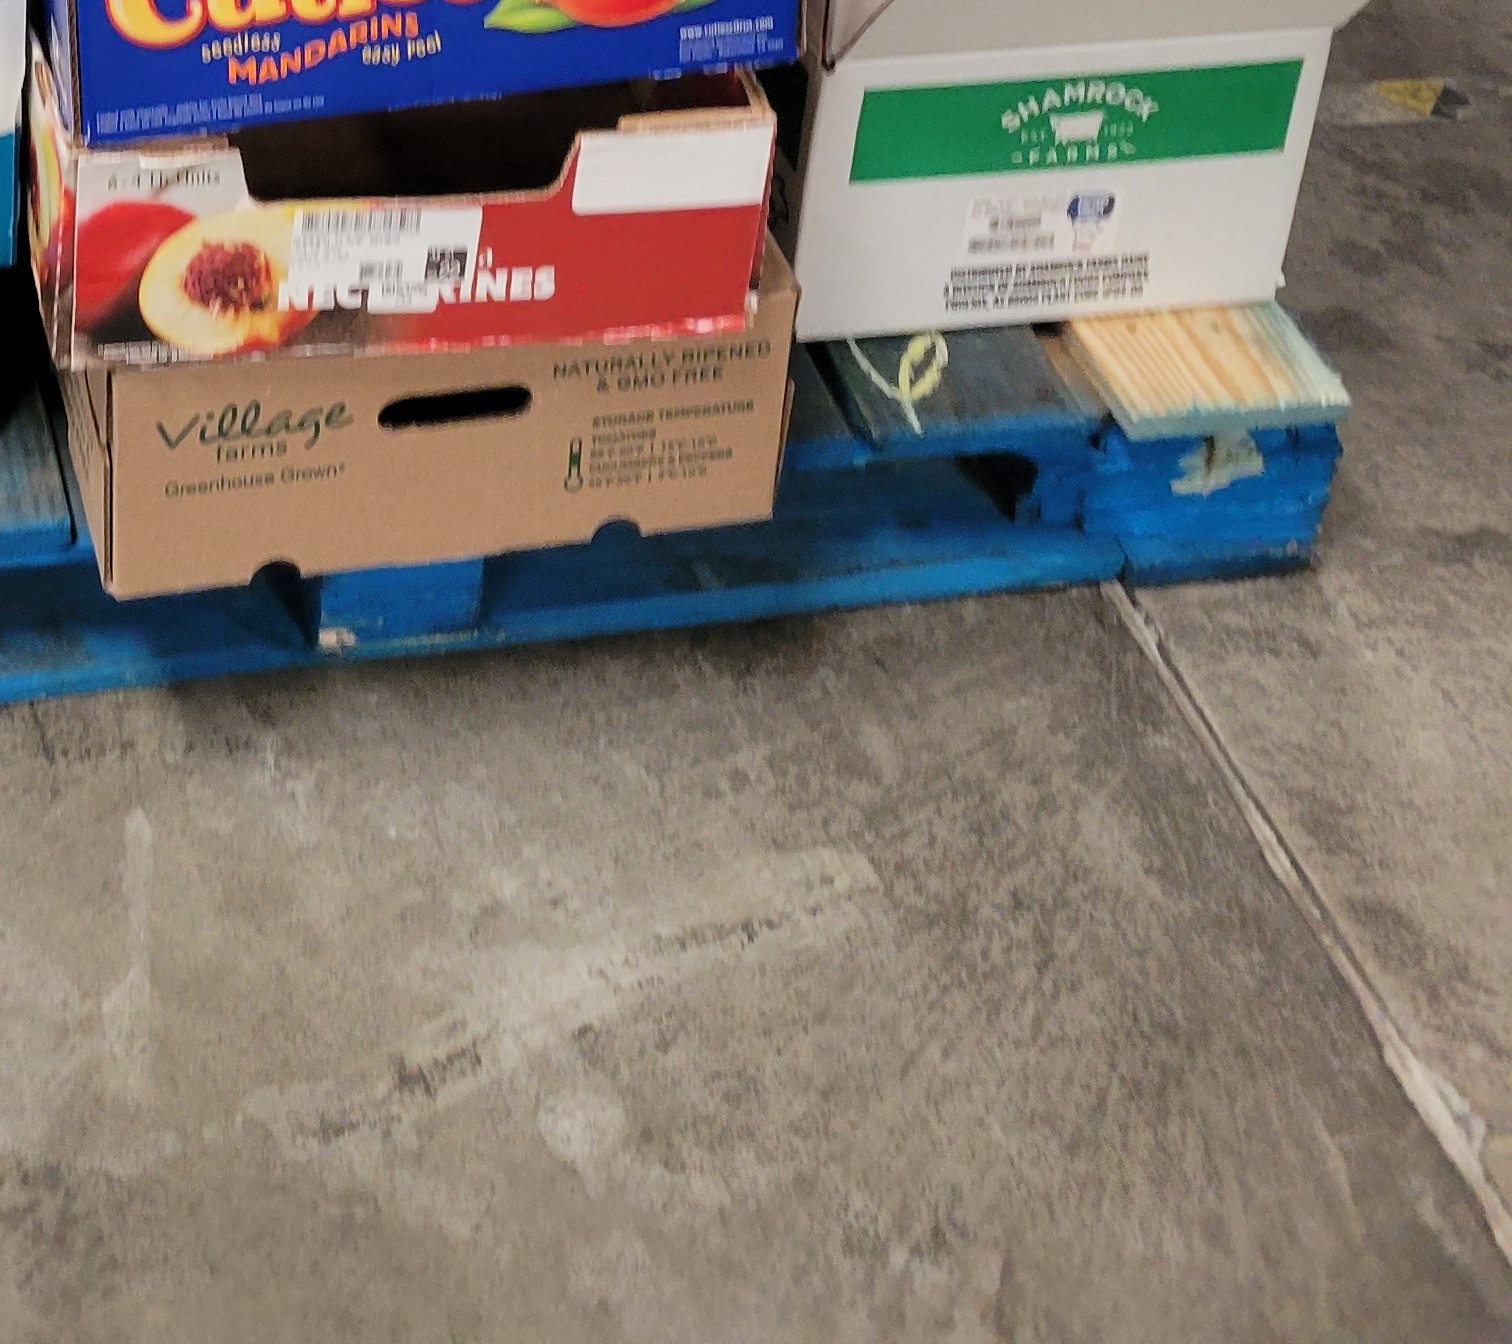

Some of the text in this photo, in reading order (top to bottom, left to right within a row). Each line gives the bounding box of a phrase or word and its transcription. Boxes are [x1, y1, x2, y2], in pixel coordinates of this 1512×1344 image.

[227, 10, 420, 85] MANDARINS
[361, 42, 401, 66] easy
[1000, 79, 1160, 134] SHAMROCK
[1028, 141, 1118, 166] FARMS
[277, 264, 556, 312] NECRINES
[552, 339, 772, 380] NATURALLY RIPENED
[616, 371, 666, 393] GMO
[671, 363, 724, 387] FREE
[155, 398, 355, 451] Village
[215, 440, 288, 463] farms
[163, 472, 275, 500] Greenhouse
